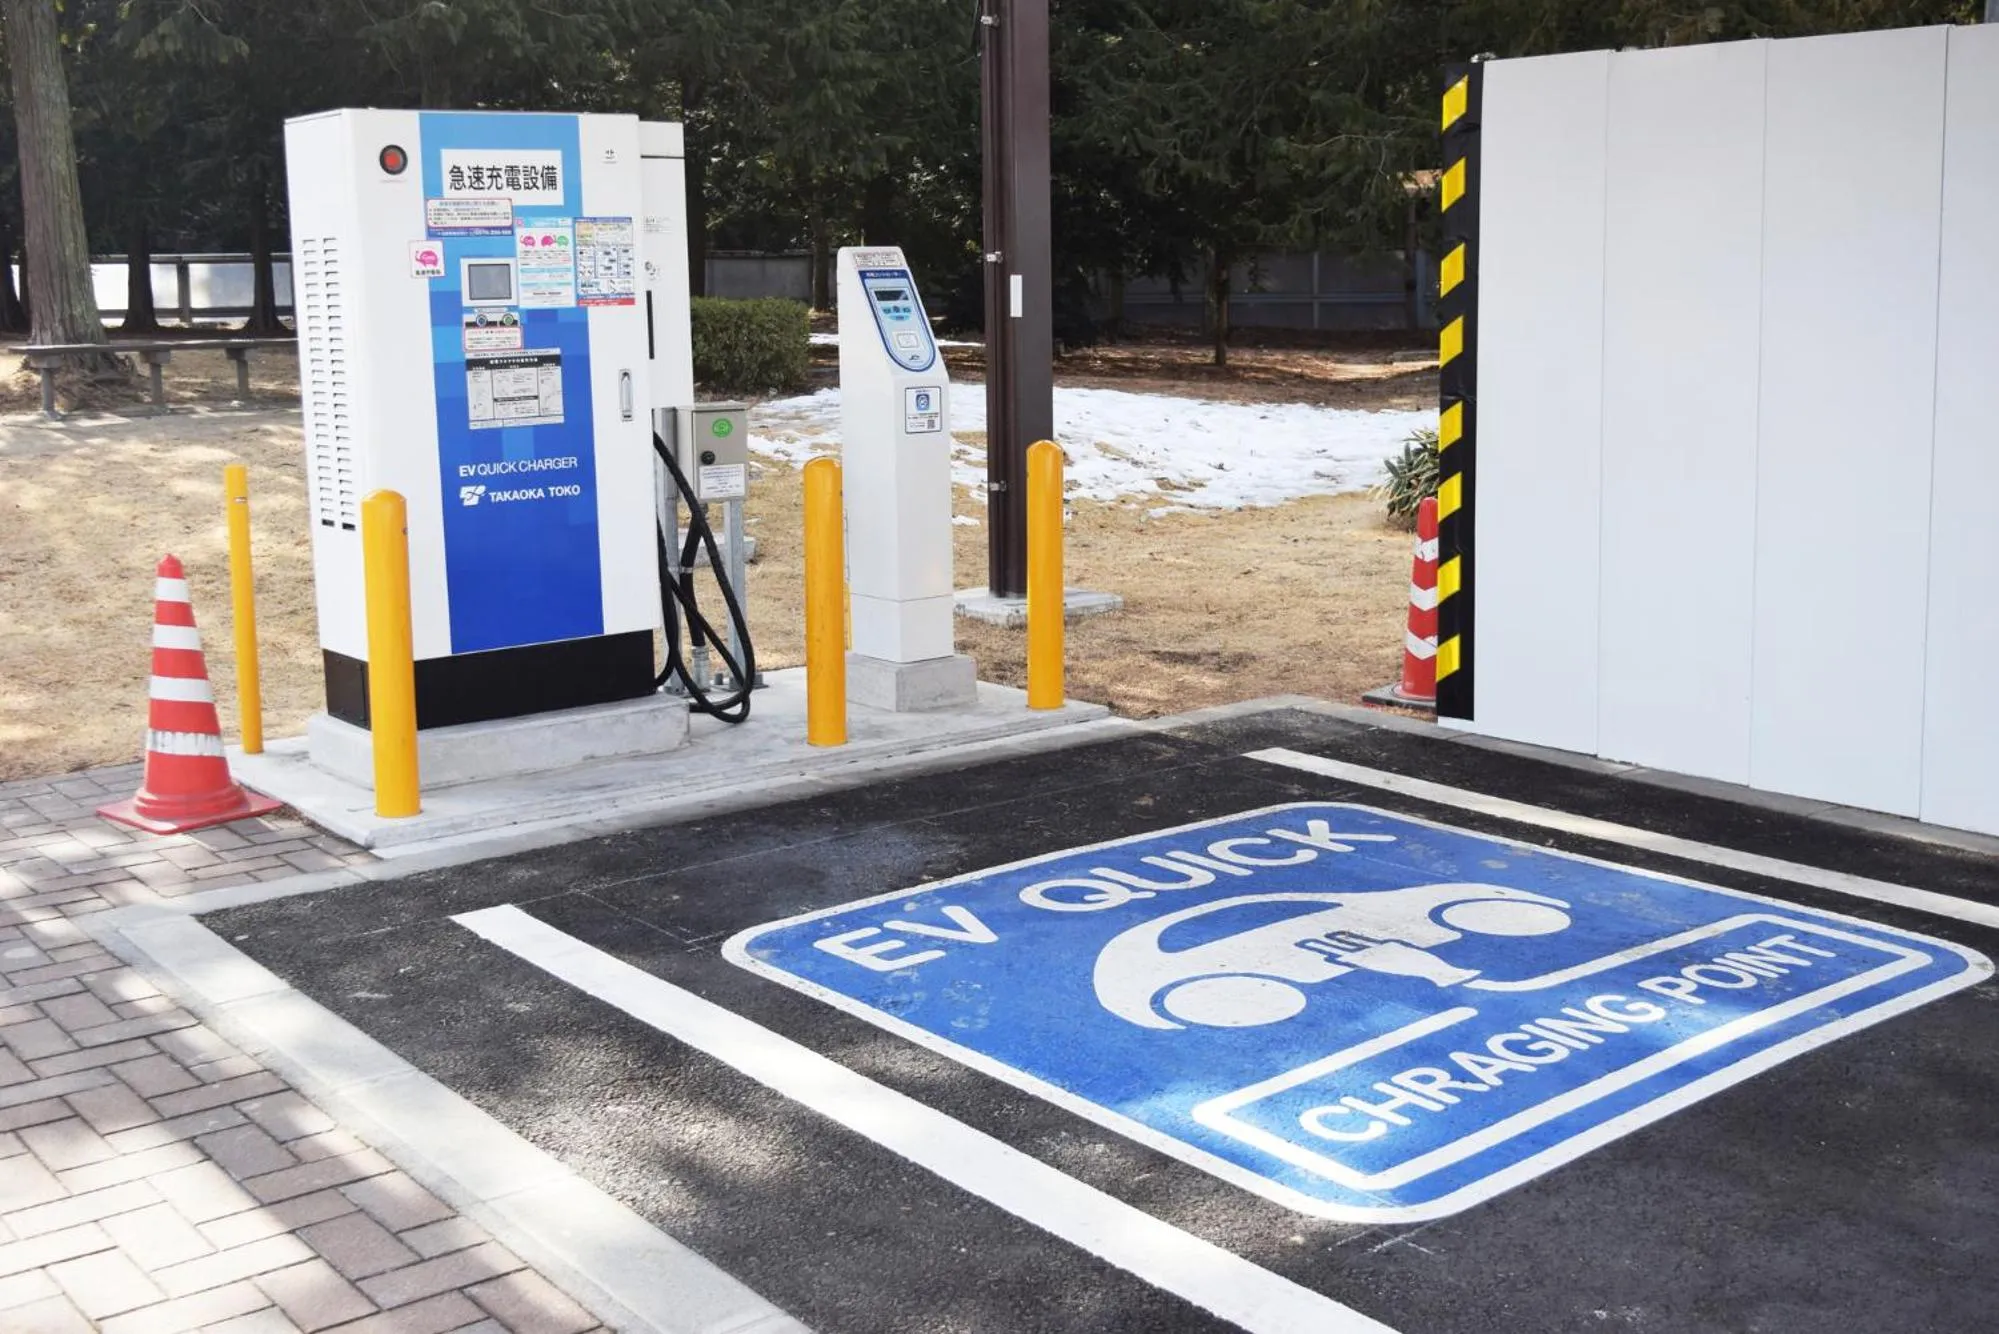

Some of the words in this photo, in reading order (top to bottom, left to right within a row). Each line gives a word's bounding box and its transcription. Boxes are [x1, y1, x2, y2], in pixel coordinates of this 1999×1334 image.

[448, 165, 557, 191] 急速充電設備
[459, 465, 476, 477] EV
[477, 461, 518, 476] QUICK
[519, 456, 578, 473] CHARGER
[489, 488, 545, 503] TAKAOKA
[548, 484, 581, 498] TOKO
[813, 906, 999, 972] EV
[1019, 819, 1397, 912] QUICK
[1300, 994, 1666, 1142] CHRAGING
[1638, 935, 1837, 1005] POINT
